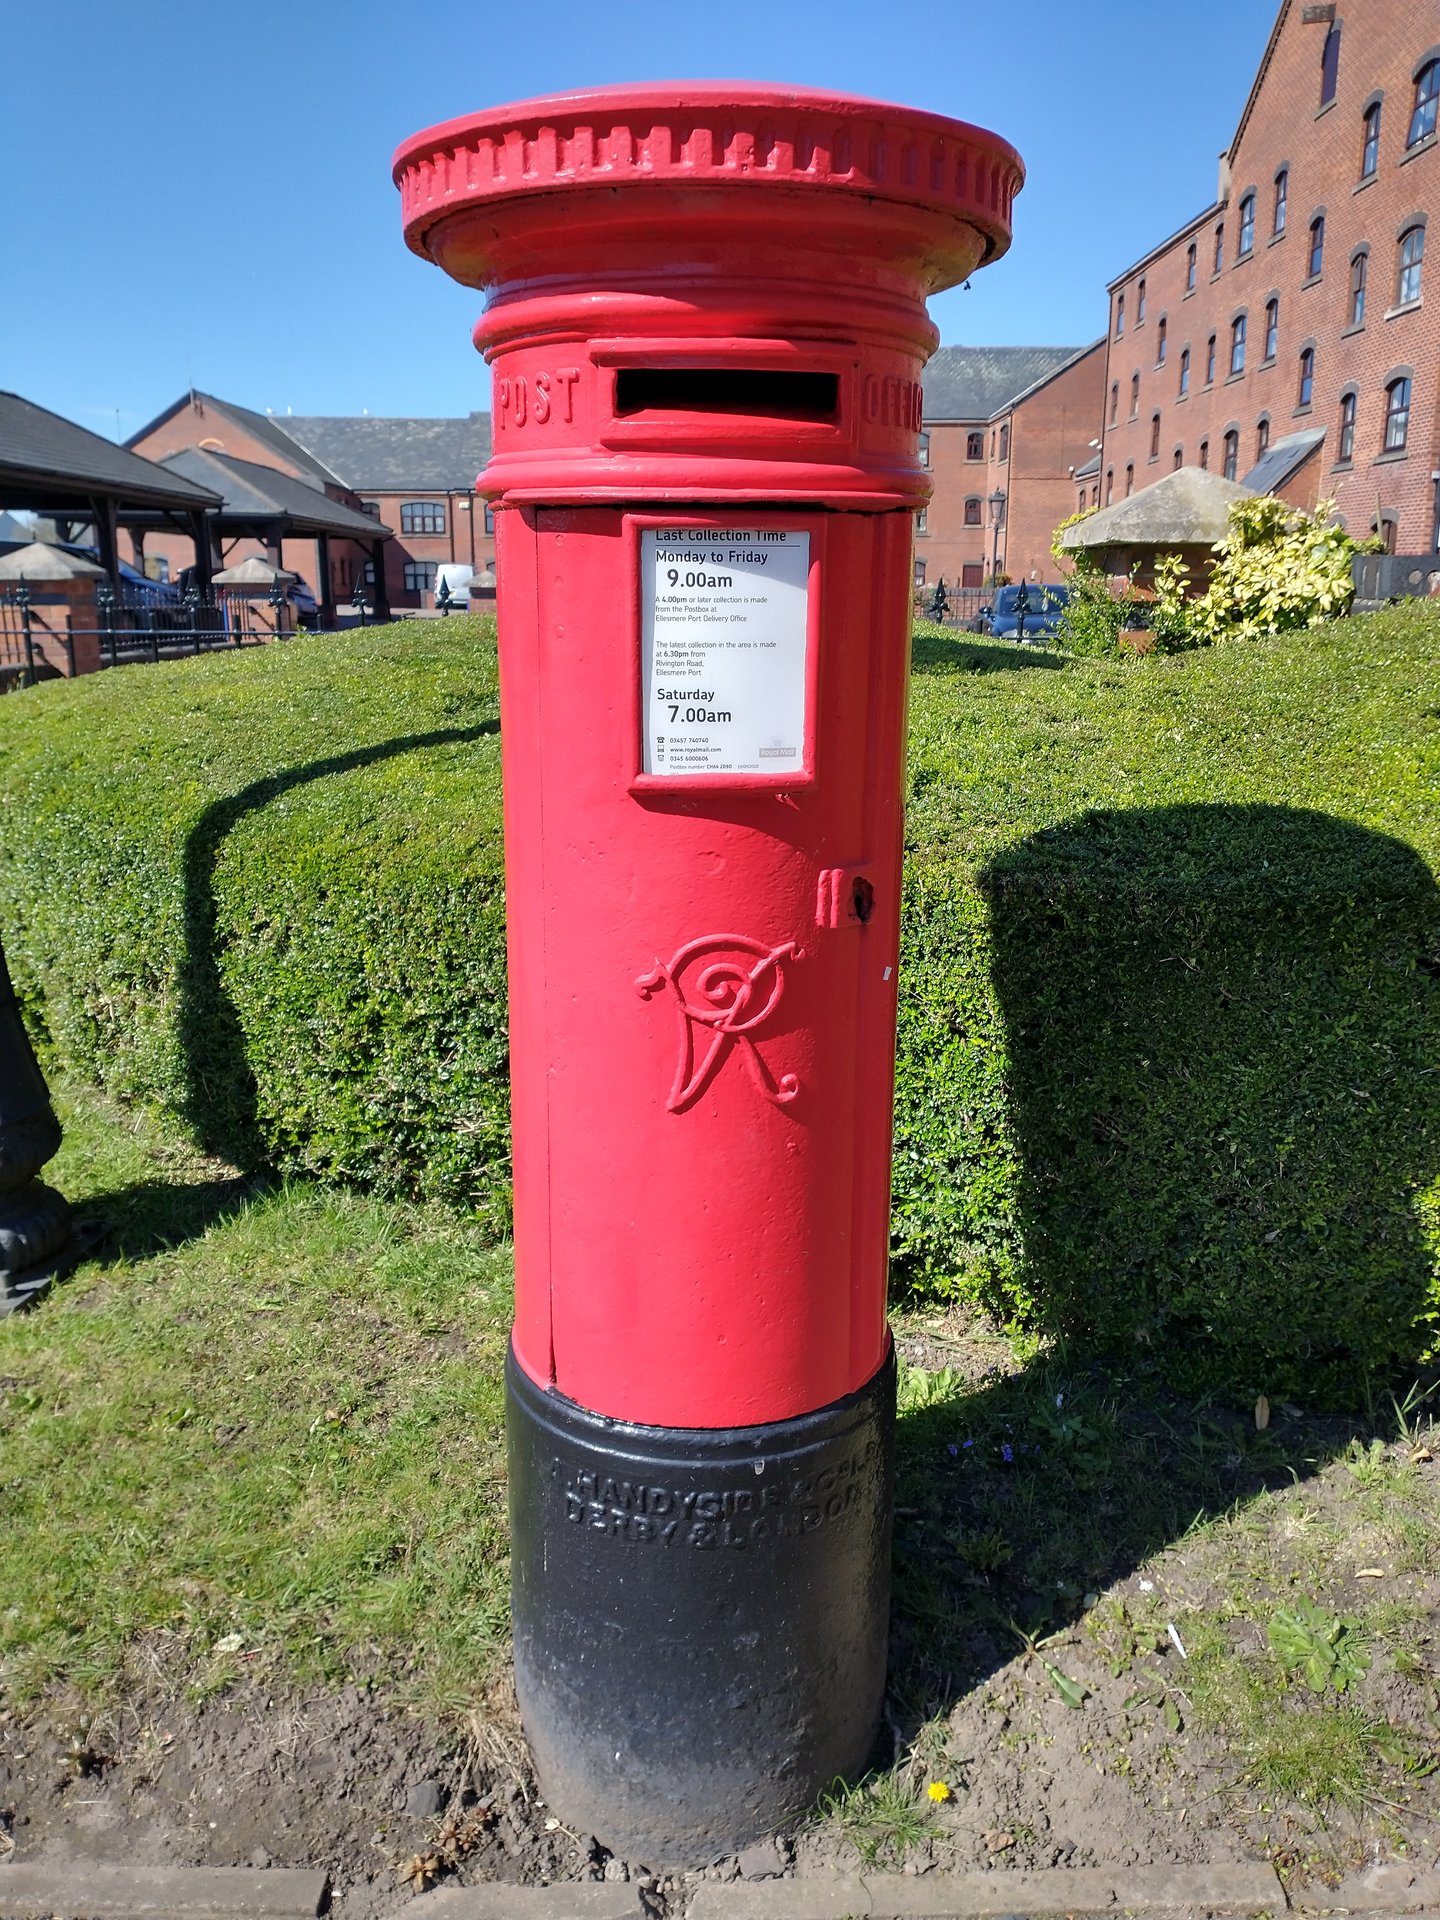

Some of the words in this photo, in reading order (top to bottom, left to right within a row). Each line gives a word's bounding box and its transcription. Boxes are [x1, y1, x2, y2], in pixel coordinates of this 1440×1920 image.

[499, 367, 580, 431] POST
[655, 530, 684, 542] Last
[688, 530, 751, 542] Collection
[755, 531, 787, 542] Time
[656, 550, 707, 565] Monday
[711, 551, 724, 563] to
[728, 550, 769, 565] Friday
[667, 568, 733, 588] 9.00am
[661, 596, 687, 605] 4.00pm
[703, 615, 729, 624] Delivery
[656, 641, 669, 649] The
[669, 641, 687, 649] latest
[687, 641, 717, 649] collection
[718, 641, 725, 649] in
[725, 641, 737, 649] the
[737, 641, 752, 649] area
[752, 641, 758, 649] is
[759, 641, 777, 649] made
[663, 650, 689, 659] 6.30pm
[655, 660, 685, 668] Rivington
[686, 660, 705, 668] Road,
[656, 688, 715, 703] Saturday
[667, 704, 732, 723] 7.00am
[669, 746, 722, 754] www.royalmail.com
[564, 1490, 679, 1548] DERBY
